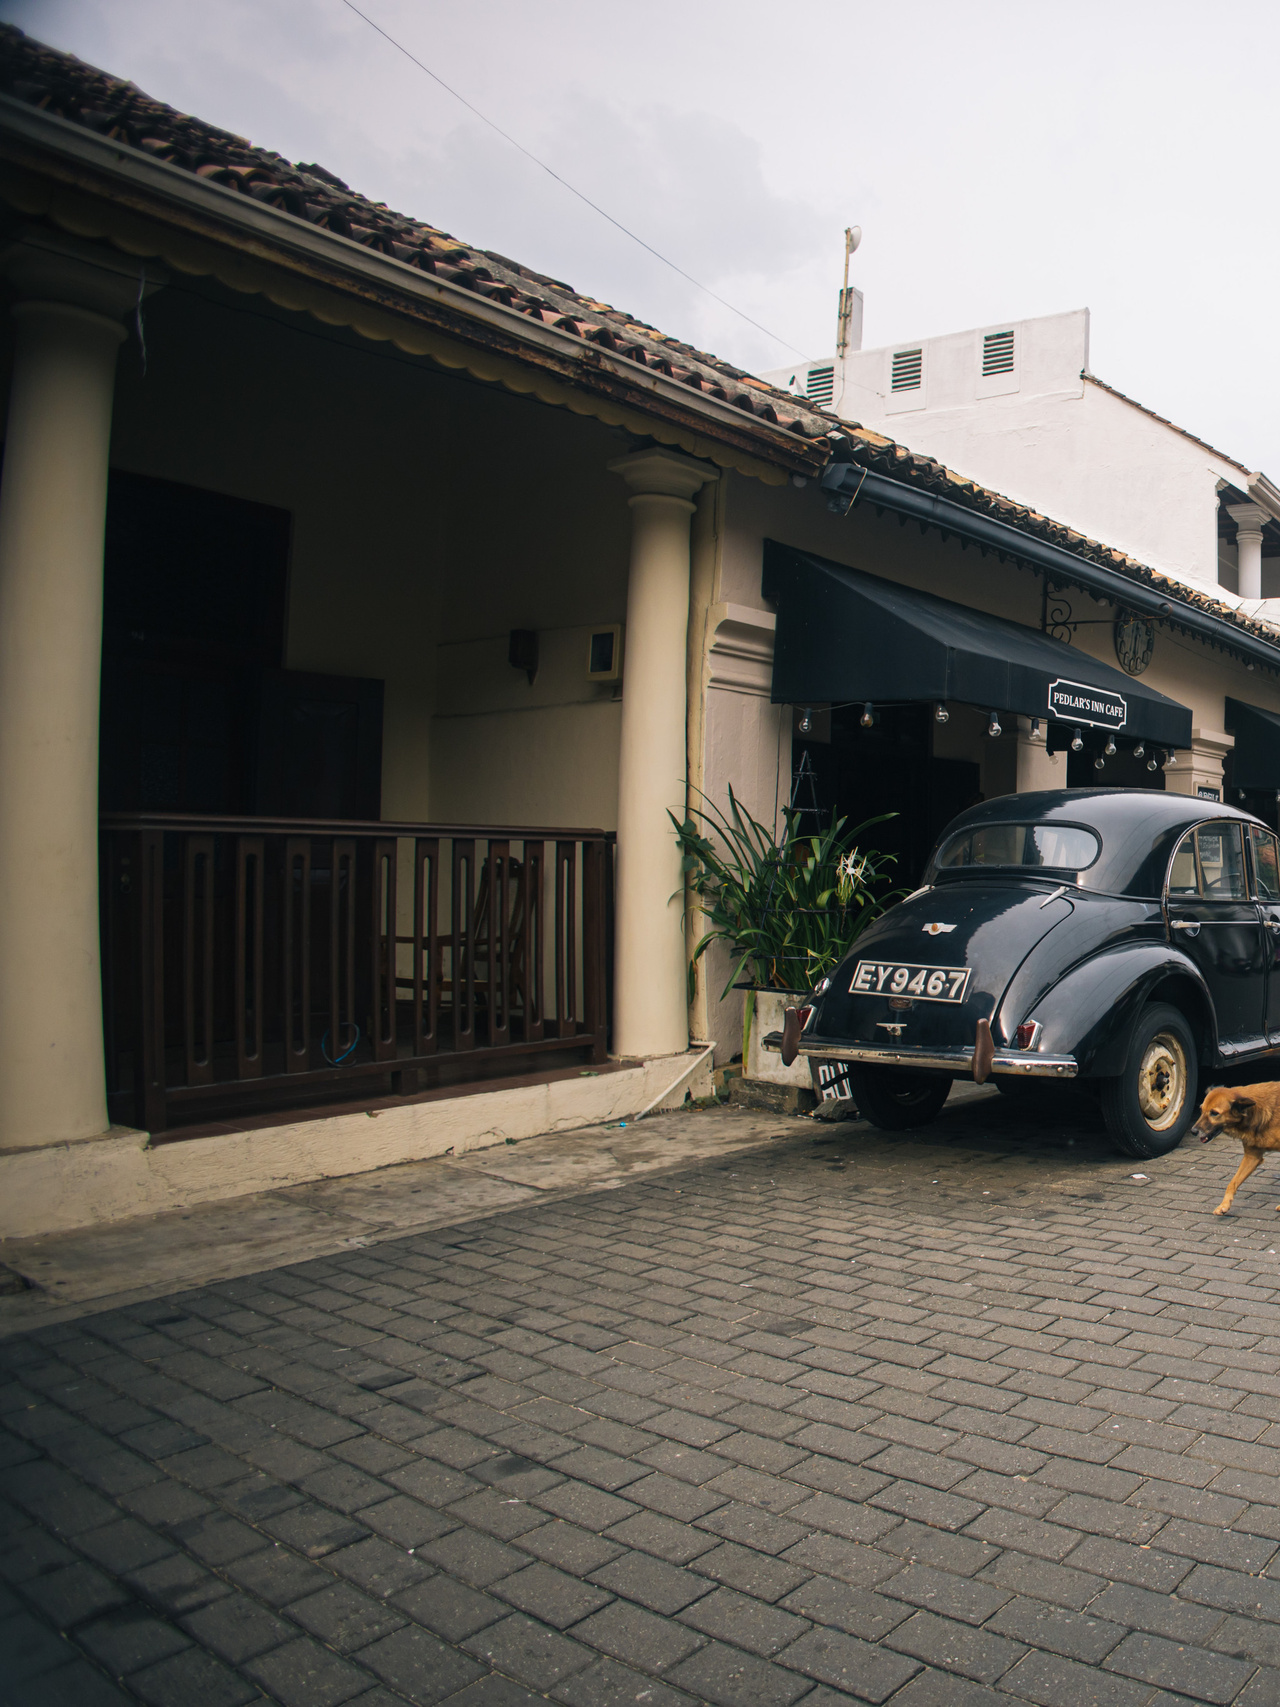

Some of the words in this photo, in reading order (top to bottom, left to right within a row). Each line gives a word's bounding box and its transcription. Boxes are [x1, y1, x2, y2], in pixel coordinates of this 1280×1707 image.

[1053, 692, 1091, 710] PEDLAR'S
[1091, 700, 1105, 714] INN
[1105, 704, 1124, 718] CAFE
